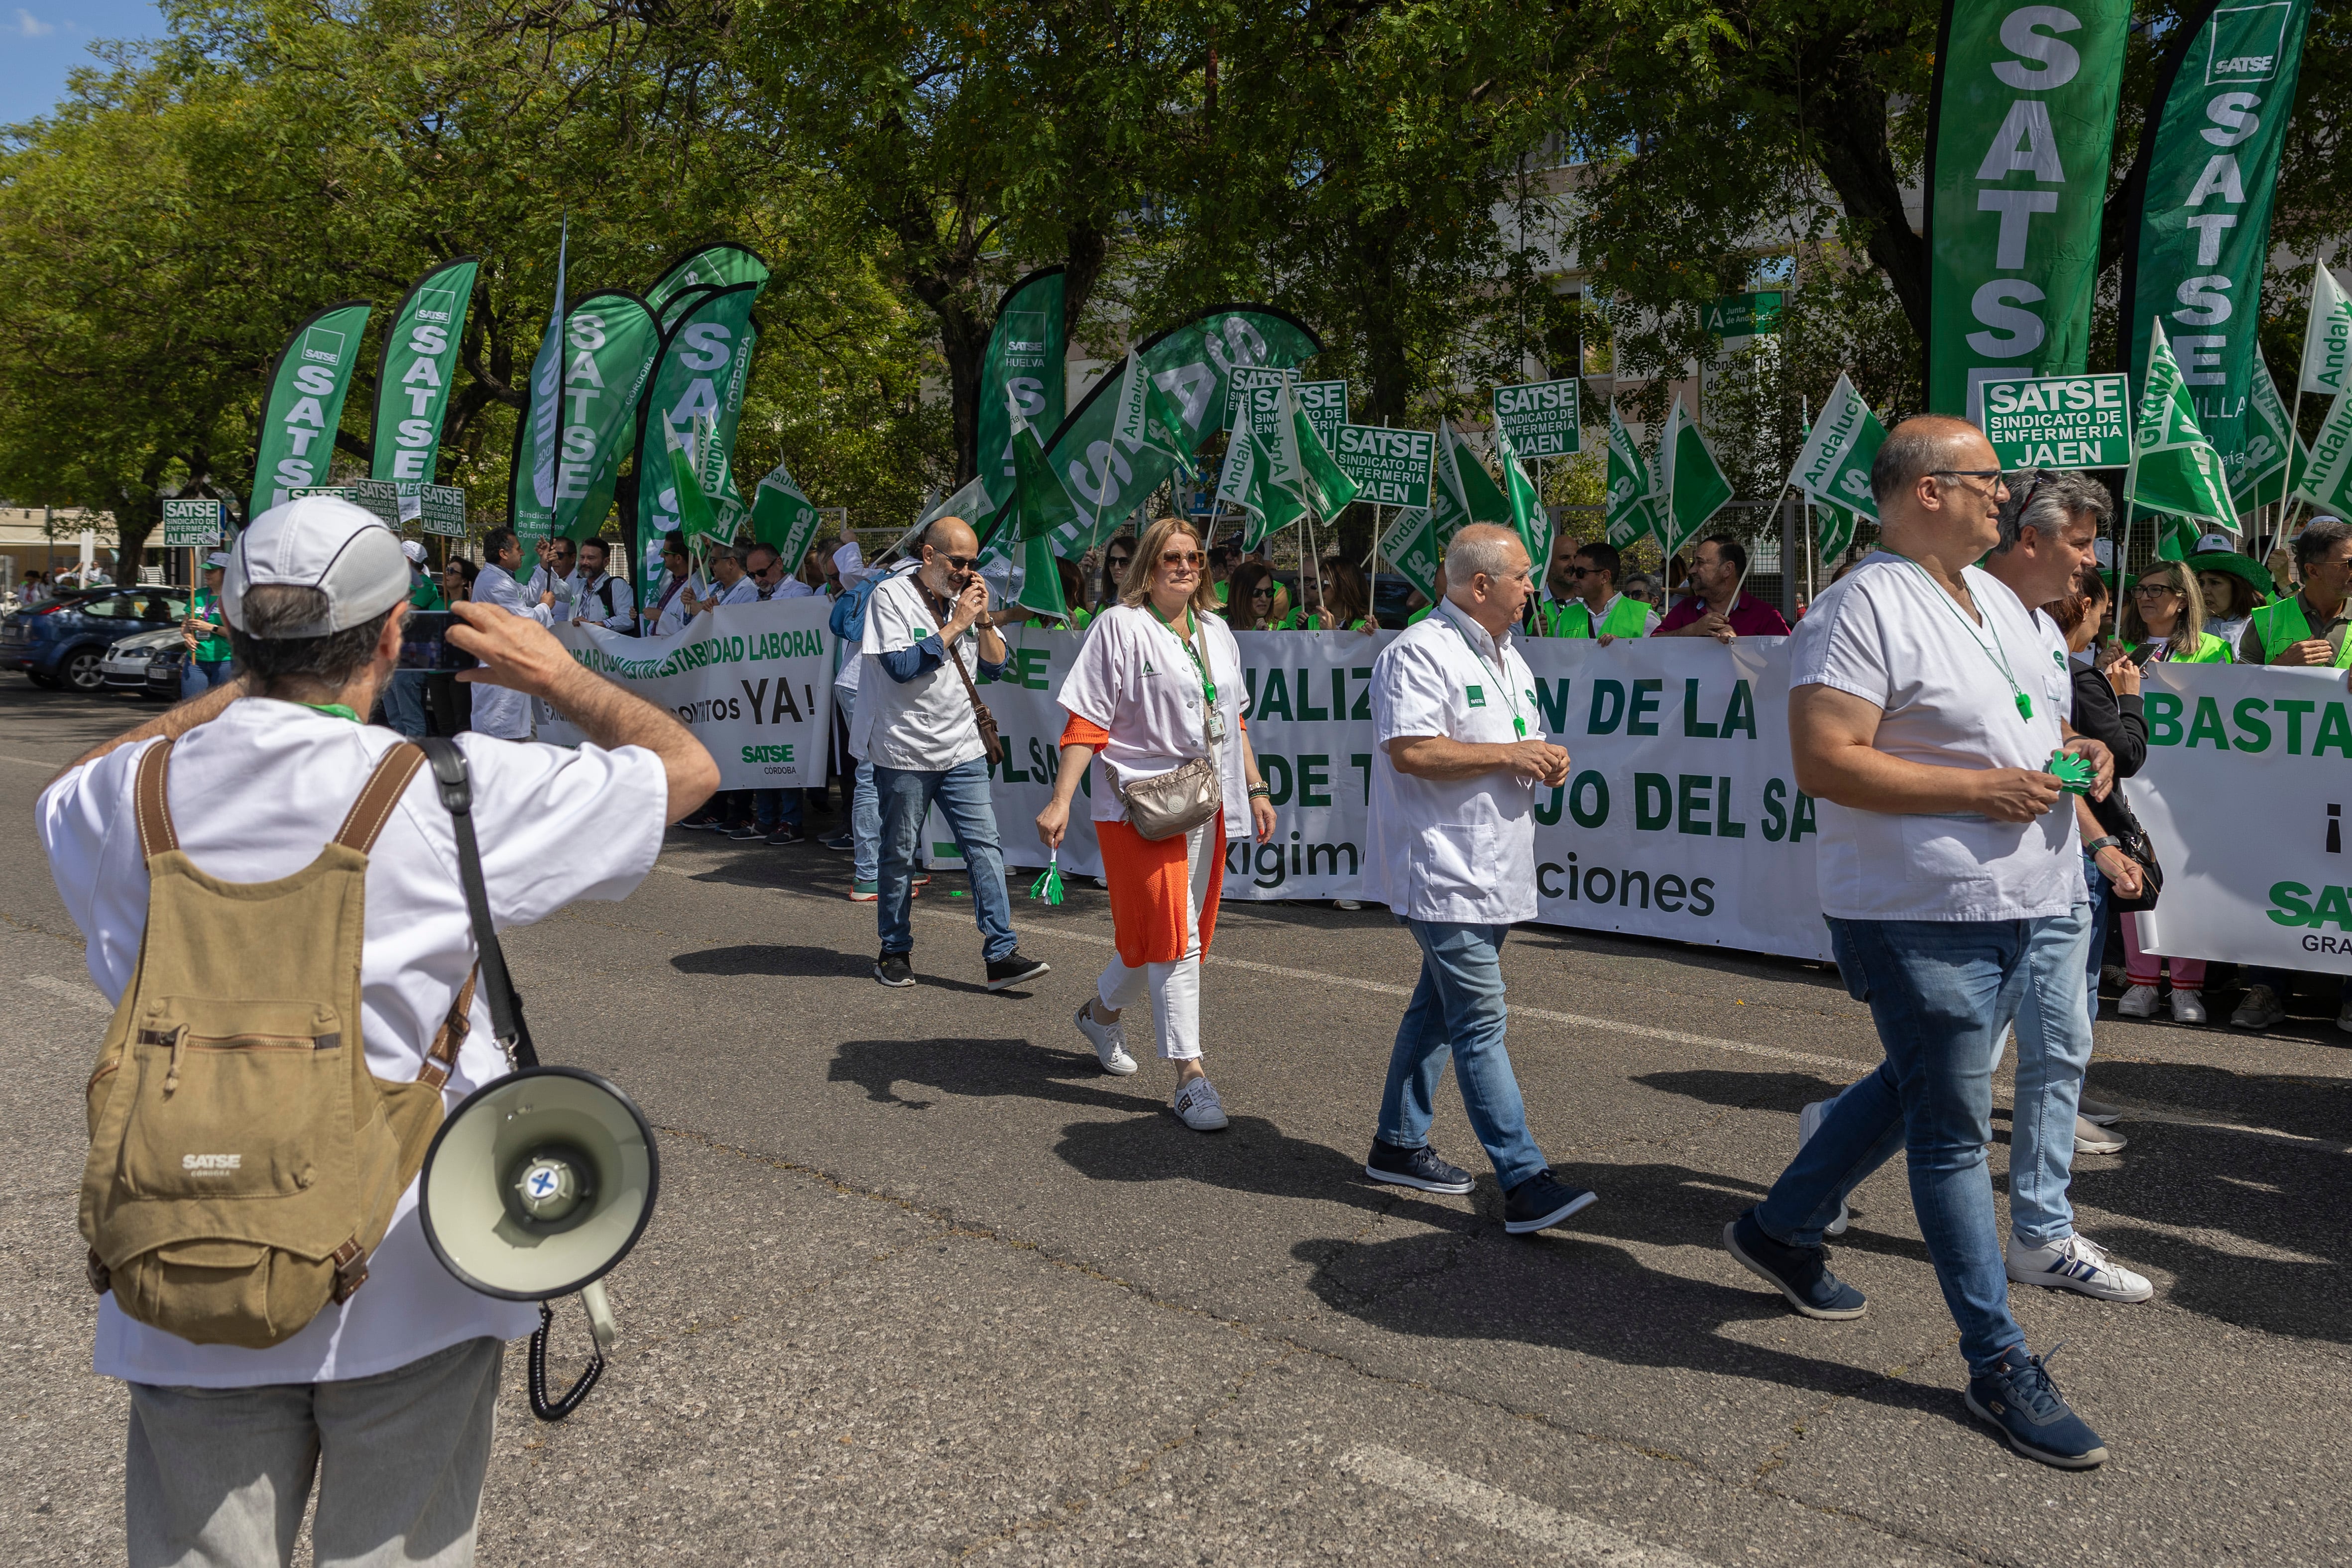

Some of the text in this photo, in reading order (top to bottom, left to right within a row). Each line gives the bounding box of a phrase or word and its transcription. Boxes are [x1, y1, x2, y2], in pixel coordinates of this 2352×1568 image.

[2216, 56, 2272, 75] SATSE
[2172, 92, 2261, 386] SATSE
[418, 309, 448, 321] SATSE
[305, 348, 337, 363] SATSE
[1008, 341, 1043, 351] SATSE
[1006, 358, 1045, 367] HUELVA
[393, 326, 448, 478] SATSE
[1498, 382, 1575, 414] SATSE
[1989, 379, 2122, 414] SATSE
[556, 315, 606, 499] SATSE
[1325, 409, 1342, 419] DE
[1500, 408, 1575, 425] SINDICATO DE
[1991, 410, 2121, 429] SINDICATO DE
[1991, 425, 2123, 443] ENFERMERIA
[1339, 429, 1429, 460] SATSE
[1515, 433, 1563, 455] JAEN
[1338, 453, 1426, 472] SINDICATO DE
[2014, 441, 2102, 467] JAEN
[358, 481, 396, 500] SATSE
[423, 486, 463, 507] SATSE
[166, 502, 217, 517] SATSE
[359, 498, 388, 507] SINDICATO
[422, 502, 452, 513] SINDICATO
[422, 510, 463, 523] ENFERMERIA
[423, 519, 464, 535] ALMERÍA
[749, 629, 824, 661] LABORAL
[1587, 678, 1663, 736] DE
[1683, 678, 1757, 740] LA
[742, 744, 795, 764] SATSE
[764, 765, 797, 775] CÓRDOBA
[1634, 772, 1746, 839] DEL
[182, 1153, 241, 1169] SATSE
